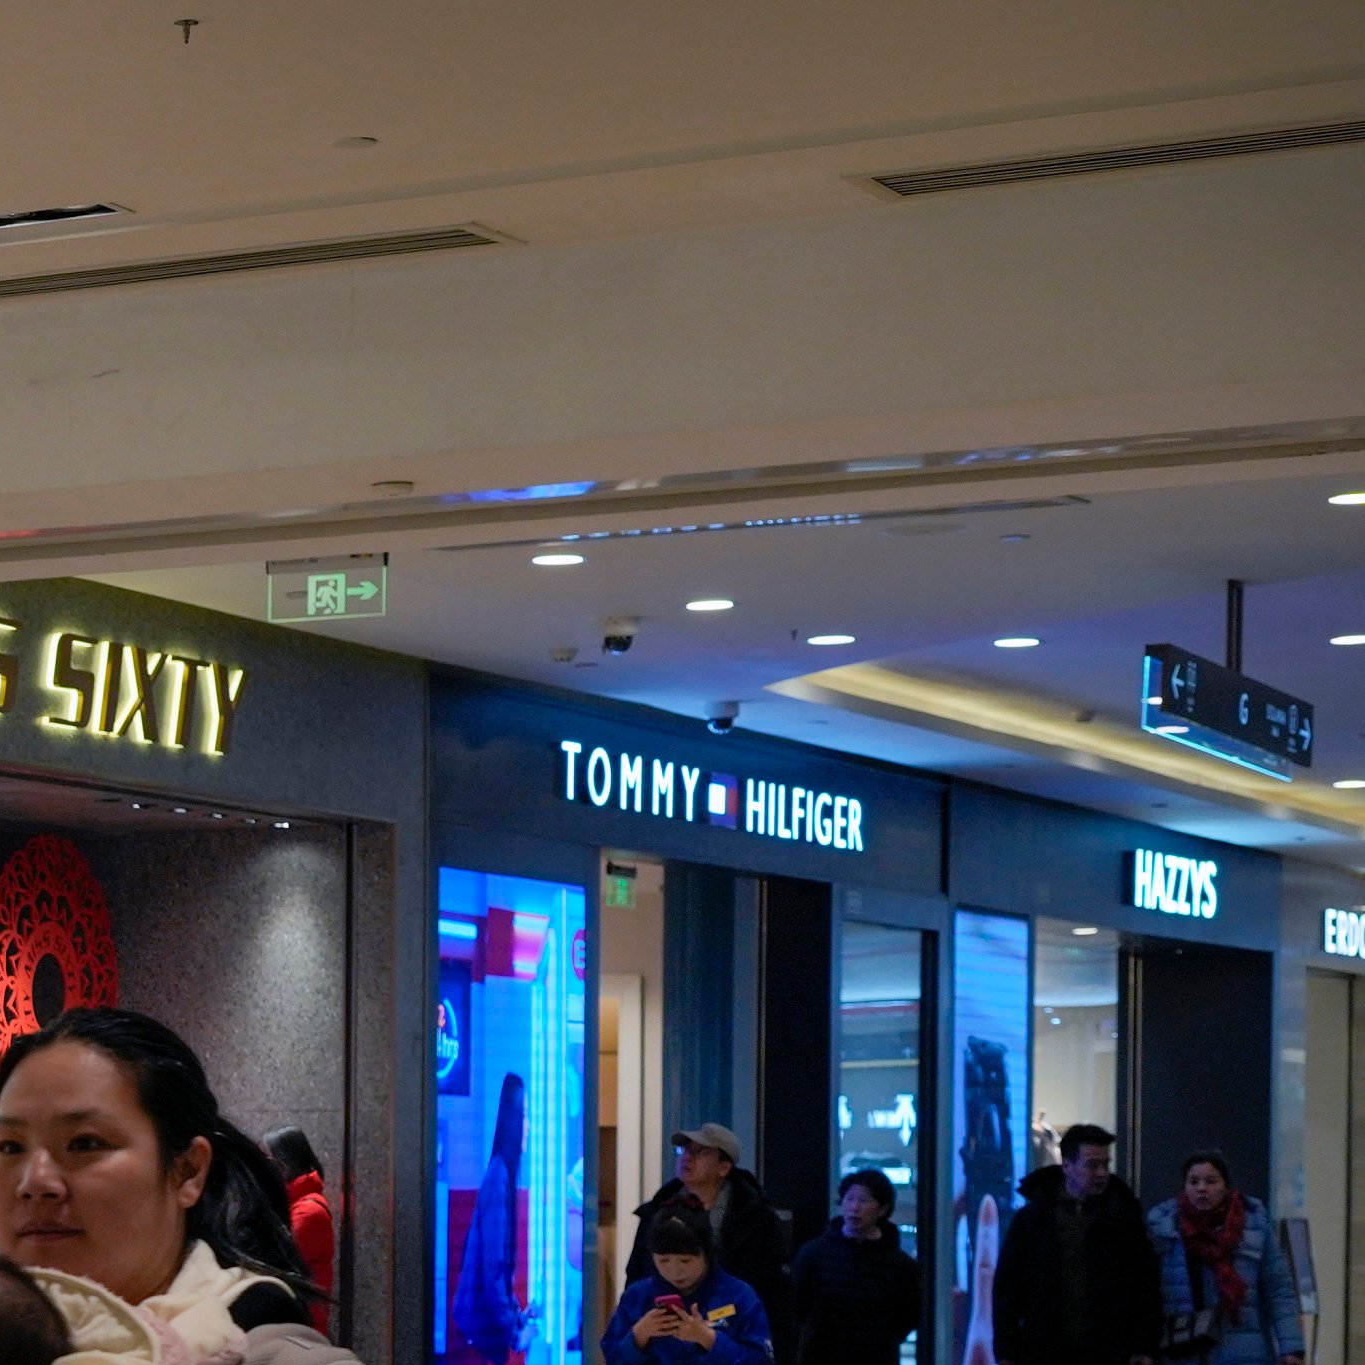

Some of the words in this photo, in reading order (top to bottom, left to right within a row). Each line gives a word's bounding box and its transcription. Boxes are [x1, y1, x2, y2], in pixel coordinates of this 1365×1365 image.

[39, 630, 249, 756] SIXTY
[560, 740, 700, 822] TOMMY
[745, 778, 864, 852] HILFIGER
[1133, 848, 1218, 919] HAZZYS
